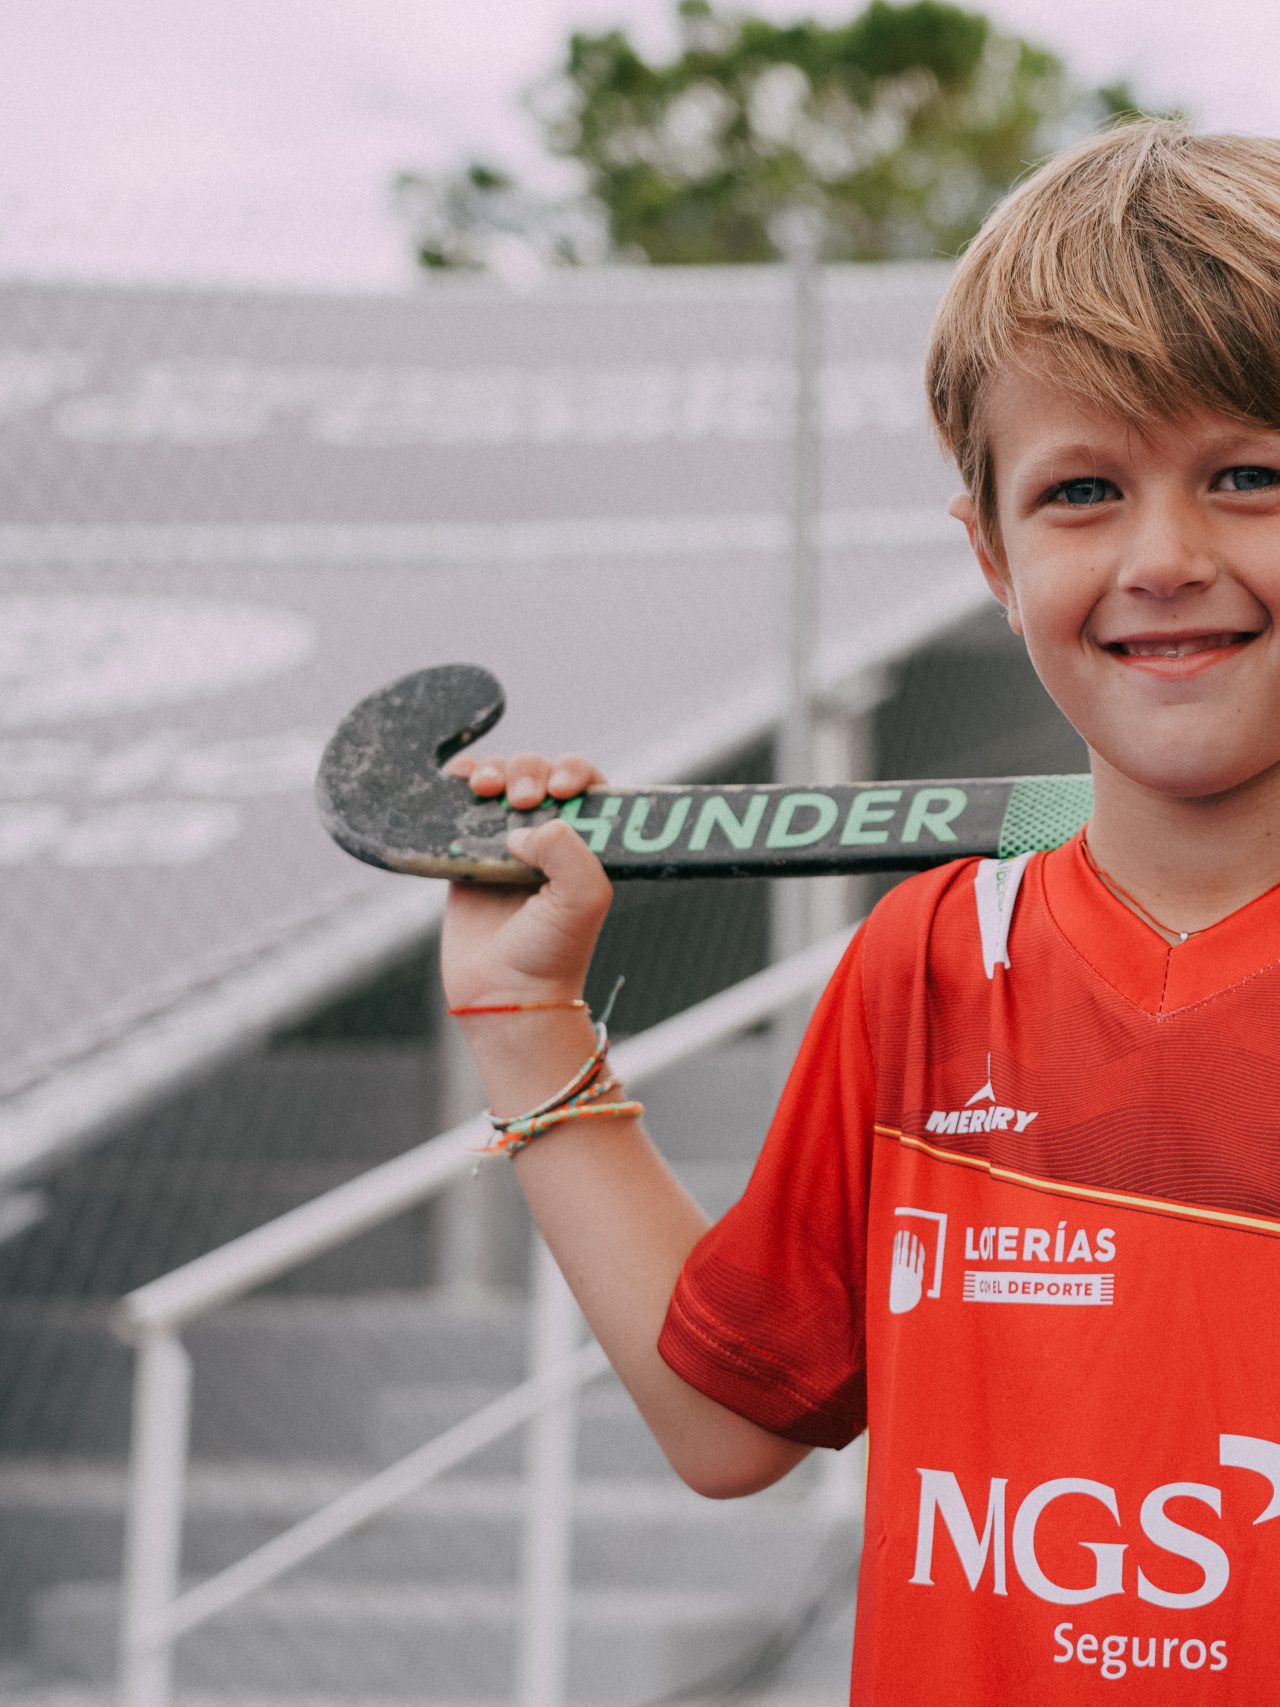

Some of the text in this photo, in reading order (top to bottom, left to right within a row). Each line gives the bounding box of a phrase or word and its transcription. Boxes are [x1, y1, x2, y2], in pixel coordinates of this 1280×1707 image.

[502, 786, 969, 853] HUNDER
[964, 1221, 1117, 1263] LOTERÍAS
[992, 1280, 1003, 1295] EL
[1008, 1280, 1093, 1297] DEPORTE
[907, 1467, 1231, 1610] MGS
[1053, 1622, 1229, 1680] Seguros
